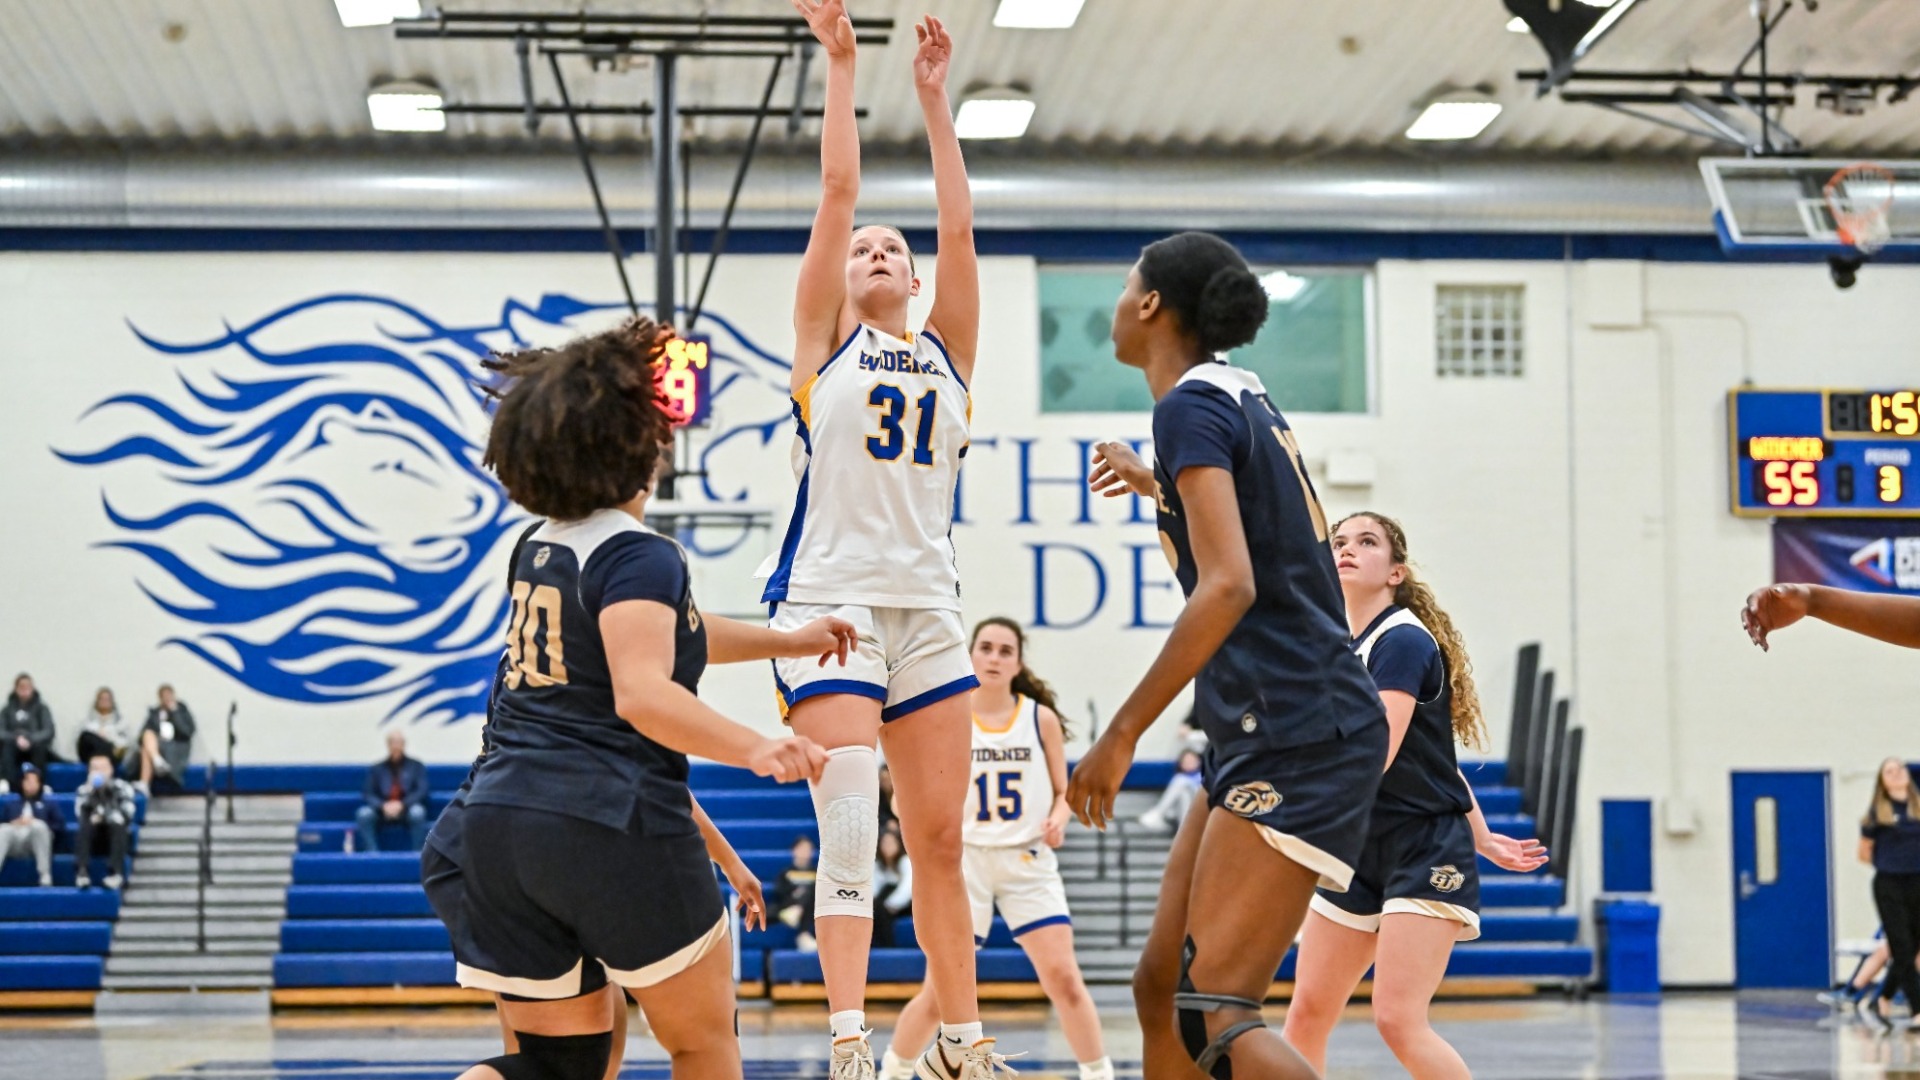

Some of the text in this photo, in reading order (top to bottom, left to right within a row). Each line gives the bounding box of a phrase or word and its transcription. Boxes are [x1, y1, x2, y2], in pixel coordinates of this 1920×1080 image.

[859, 349, 947, 379] WDEN
[864, 381, 938, 468] 31
[1871, 391, 1920, 435] 1:5
[1764, 461, 1819, 506] 55
[1879, 465, 1901, 502] 3
[974, 770, 1023, 823] 15
